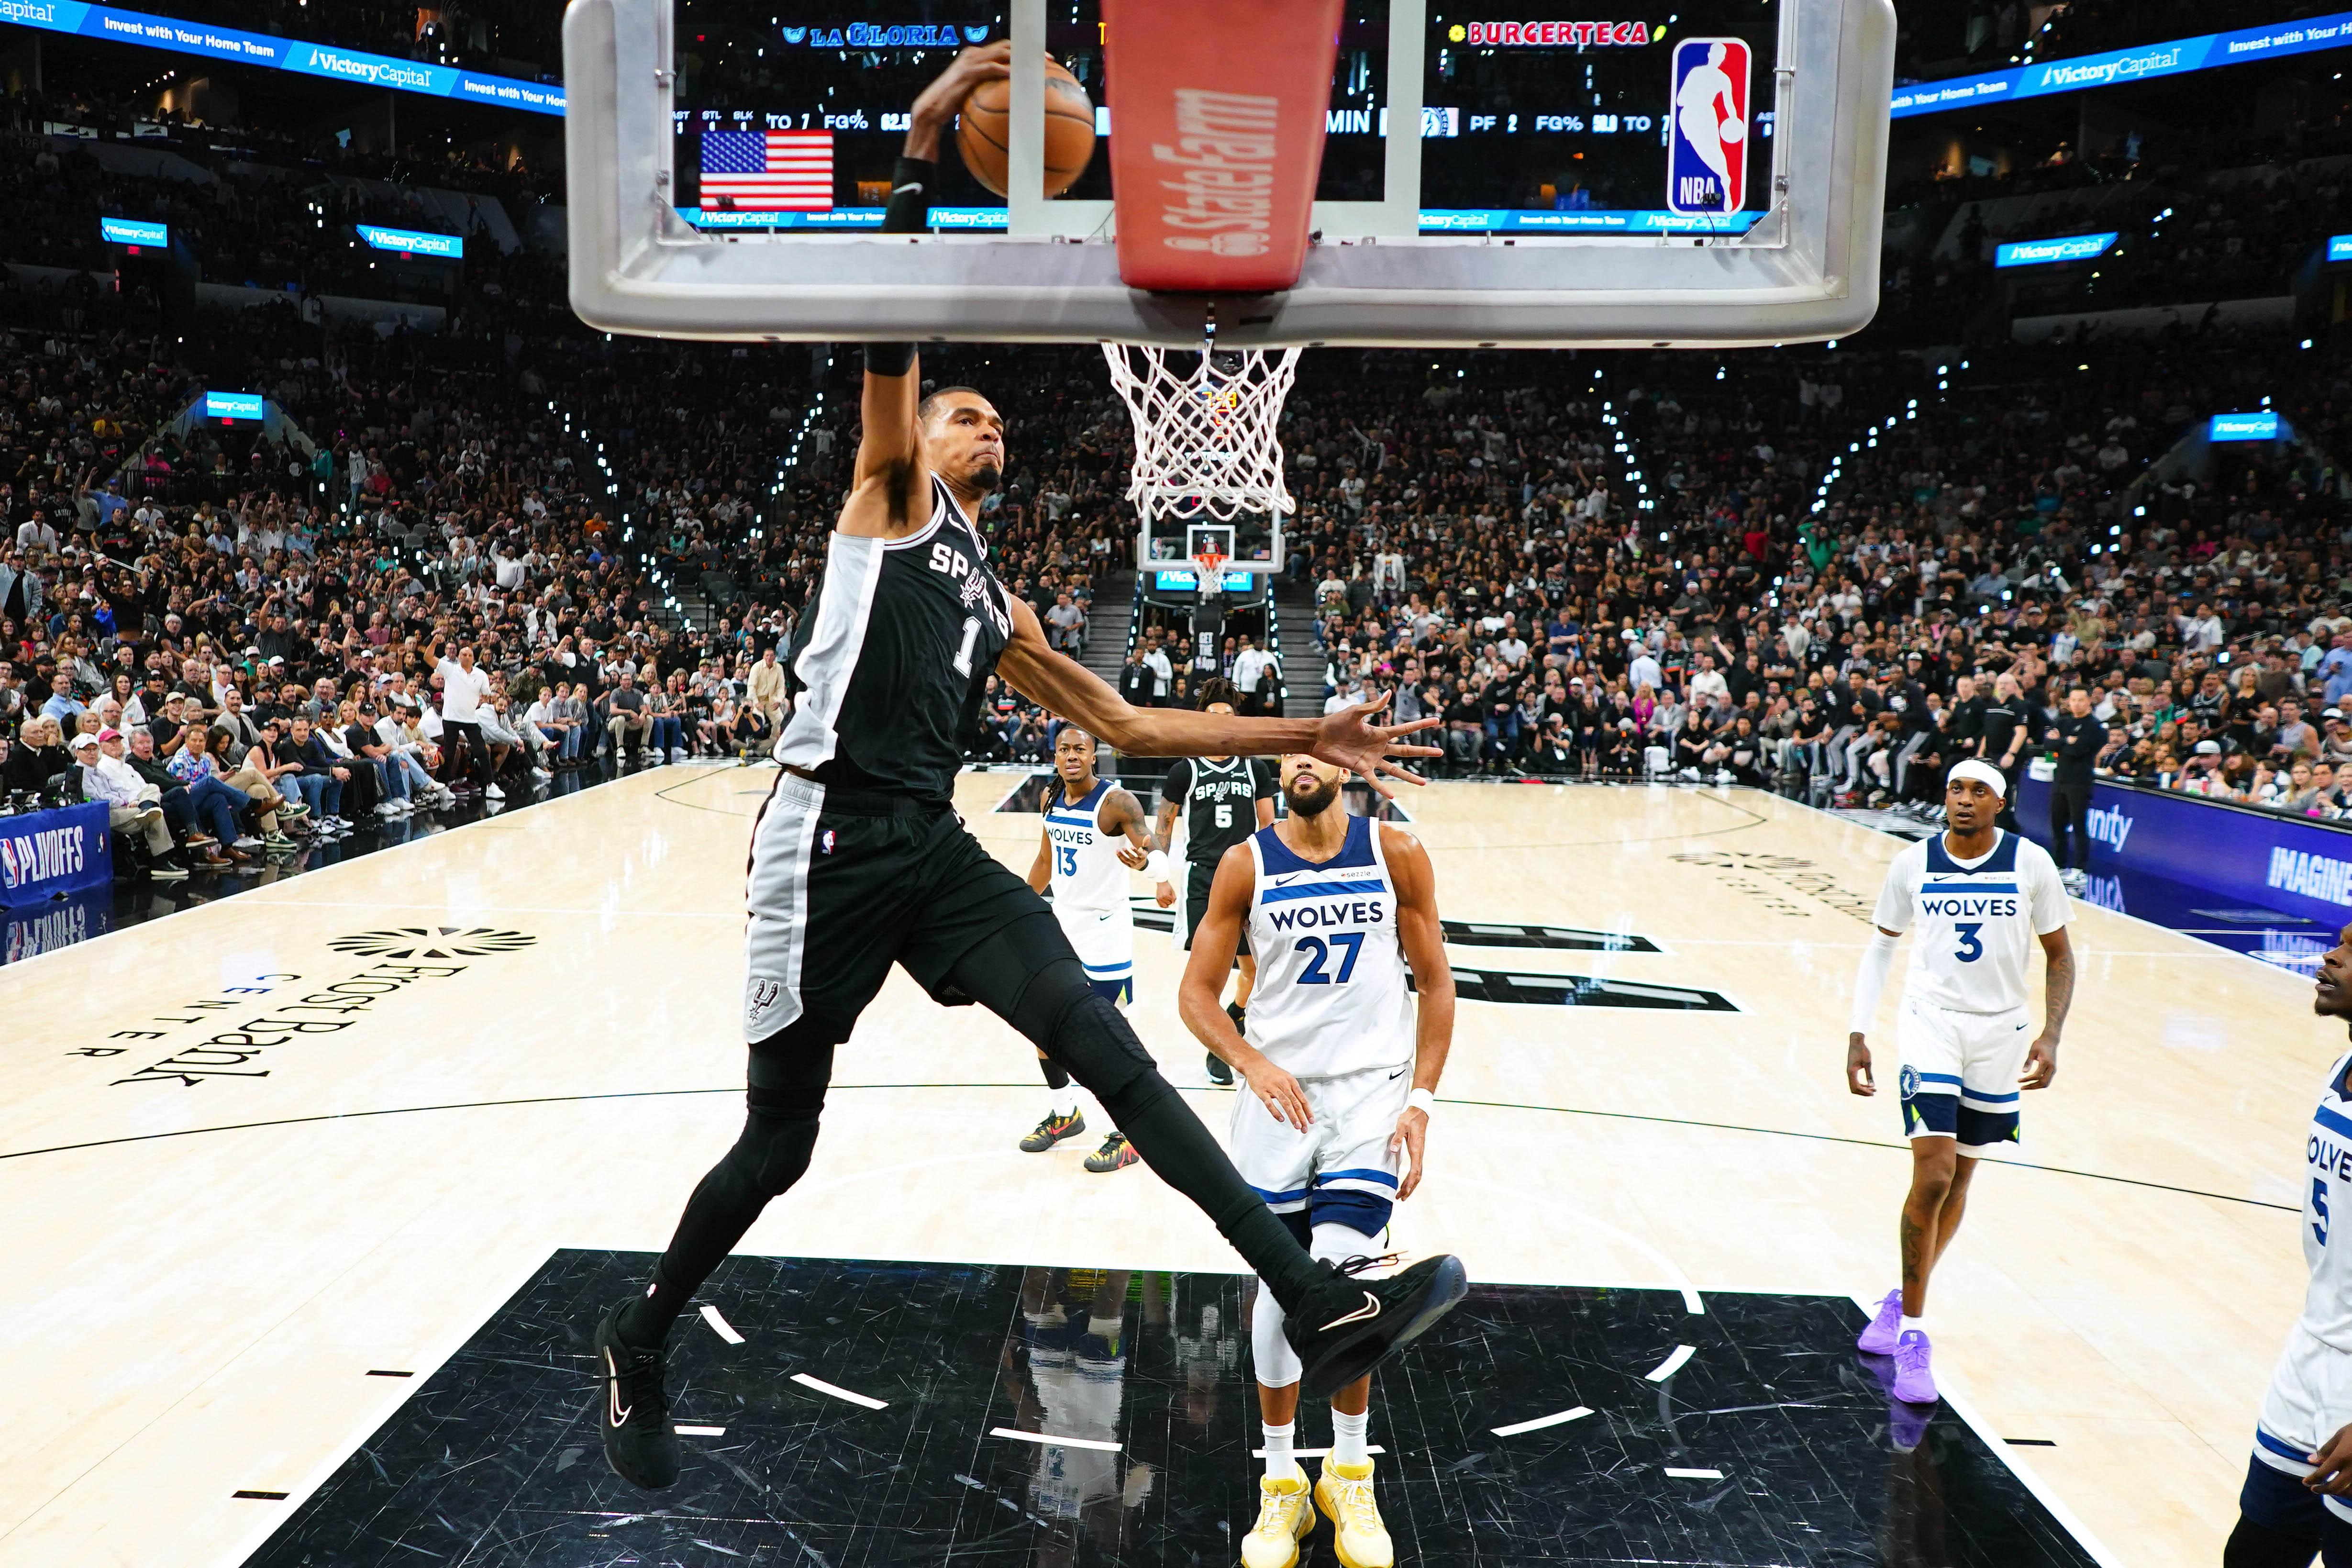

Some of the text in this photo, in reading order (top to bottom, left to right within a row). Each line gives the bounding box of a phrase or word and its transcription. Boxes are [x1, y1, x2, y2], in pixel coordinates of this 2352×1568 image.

[104, 17, 274, 57] Invest with Your Home Team
[810, 22, 960, 47] LA GLORIA
[1468, 21, 1649, 45] BURGERTECA
[2229, 37, 2270, 53] Invest
[2273, 31, 2303, 45] with
[2304, 26, 2338, 41] Your
[465, 80, 568, 108] Invest with Your Hom
[1914, 93, 1940, 105] Your
[1941, 88, 1975, 100] Home
[1975, 81, 2008, 94] Team
[671, 111, 754, 120] AST STL BLK
[769, 115, 792, 129] TO
[824, 110, 868, 129] FG%
[1325, 111, 1370, 133] MIN
[1470, 116, 1496, 132] PF
[1536, 116, 1583, 132] FG%
[1623, 116, 1651, 132] TO
[953, 616, 982, 678] 1
[1195, 781, 1252, 803] SPURS
[1215, 804, 1232, 828] 5
[1048, 828, 1093, 845] WOLVES
[15, 826, 83, 884] PLAYOFFS
[1056, 845, 1077, 877] 13
[1269, 901, 1383, 932] WOLVES
[1922, 900, 2017, 916] WOLVES
[1954, 923, 1983, 962] 3
[1294, 932, 1365, 985] 27
[2307, 1133, 2352, 1183] OLVE
[2312, 1177, 2329, 1247] 5
